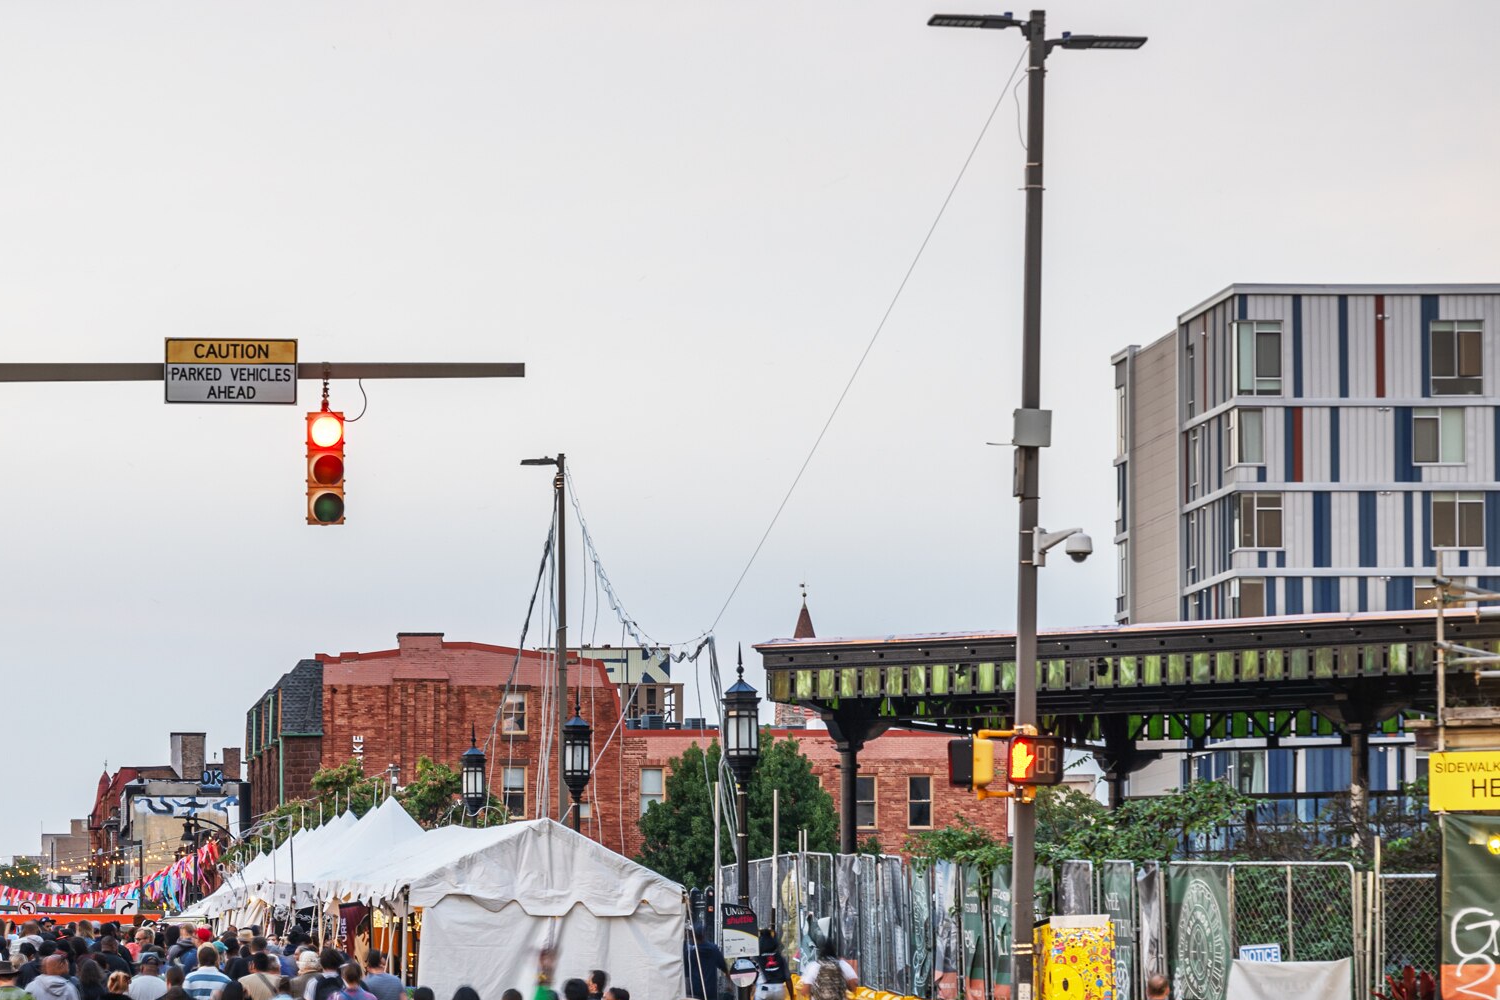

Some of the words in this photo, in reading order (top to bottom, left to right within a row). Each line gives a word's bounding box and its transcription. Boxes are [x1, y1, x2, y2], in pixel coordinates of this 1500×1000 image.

[194, 343, 270, 359] CAUTION
[171, 367, 222, 382] PARKED
[230, 367, 291, 382] VEHICLES
[207, 385, 256, 400] AHEAD
[1435, 761, 1500, 774] SIDEWALK
[201, 769, 223, 786] OK
[1242, 949, 1279, 962] NOTICE
